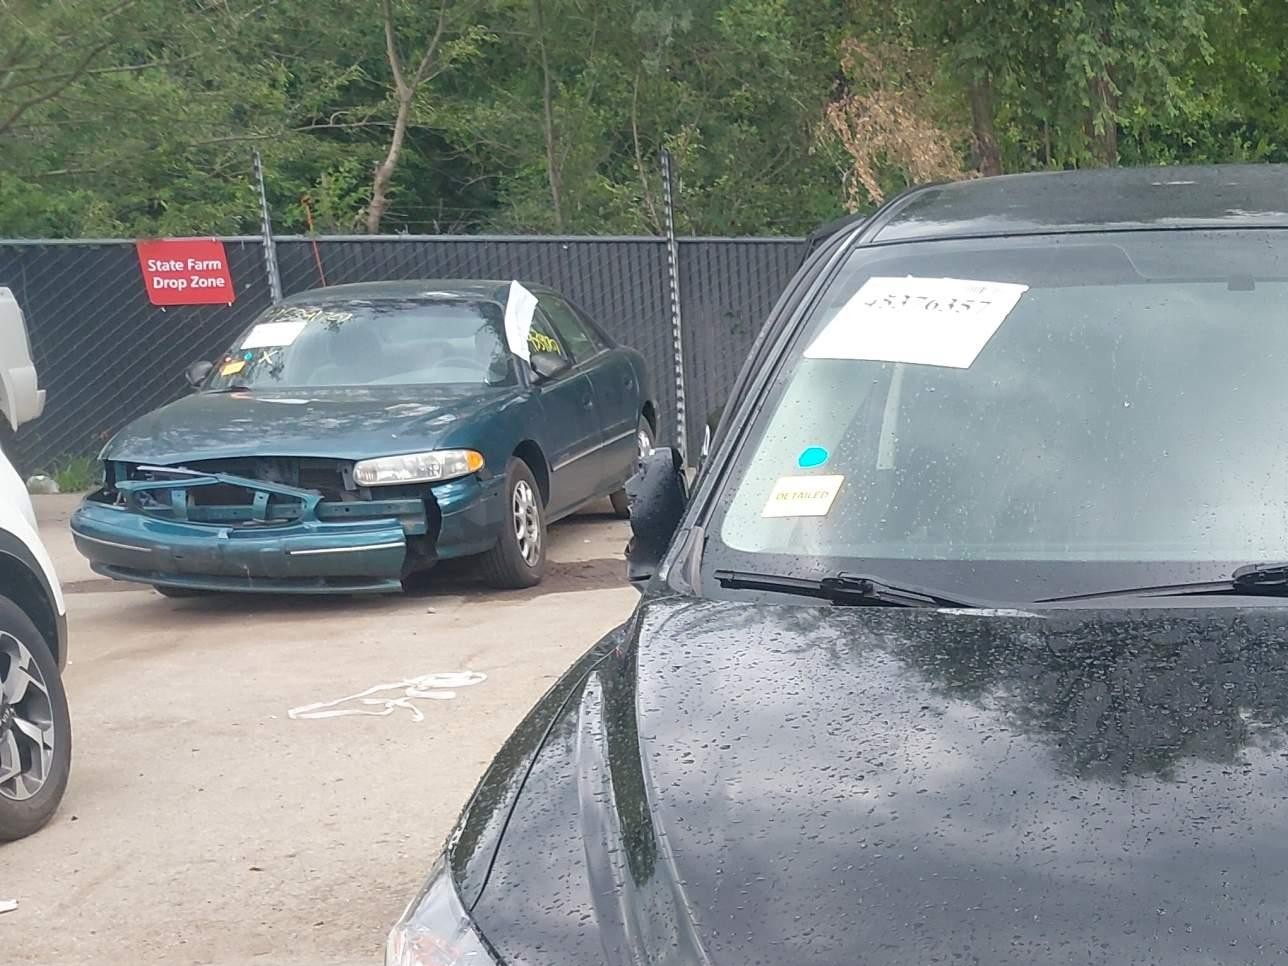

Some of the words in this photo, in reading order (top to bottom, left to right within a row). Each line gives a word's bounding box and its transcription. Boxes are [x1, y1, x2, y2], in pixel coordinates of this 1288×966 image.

[147, 259, 184, 272] State
[187, 258, 222, 271] Farm
[152, 276, 187, 291] Drop
[190, 275, 225, 288] Zone
